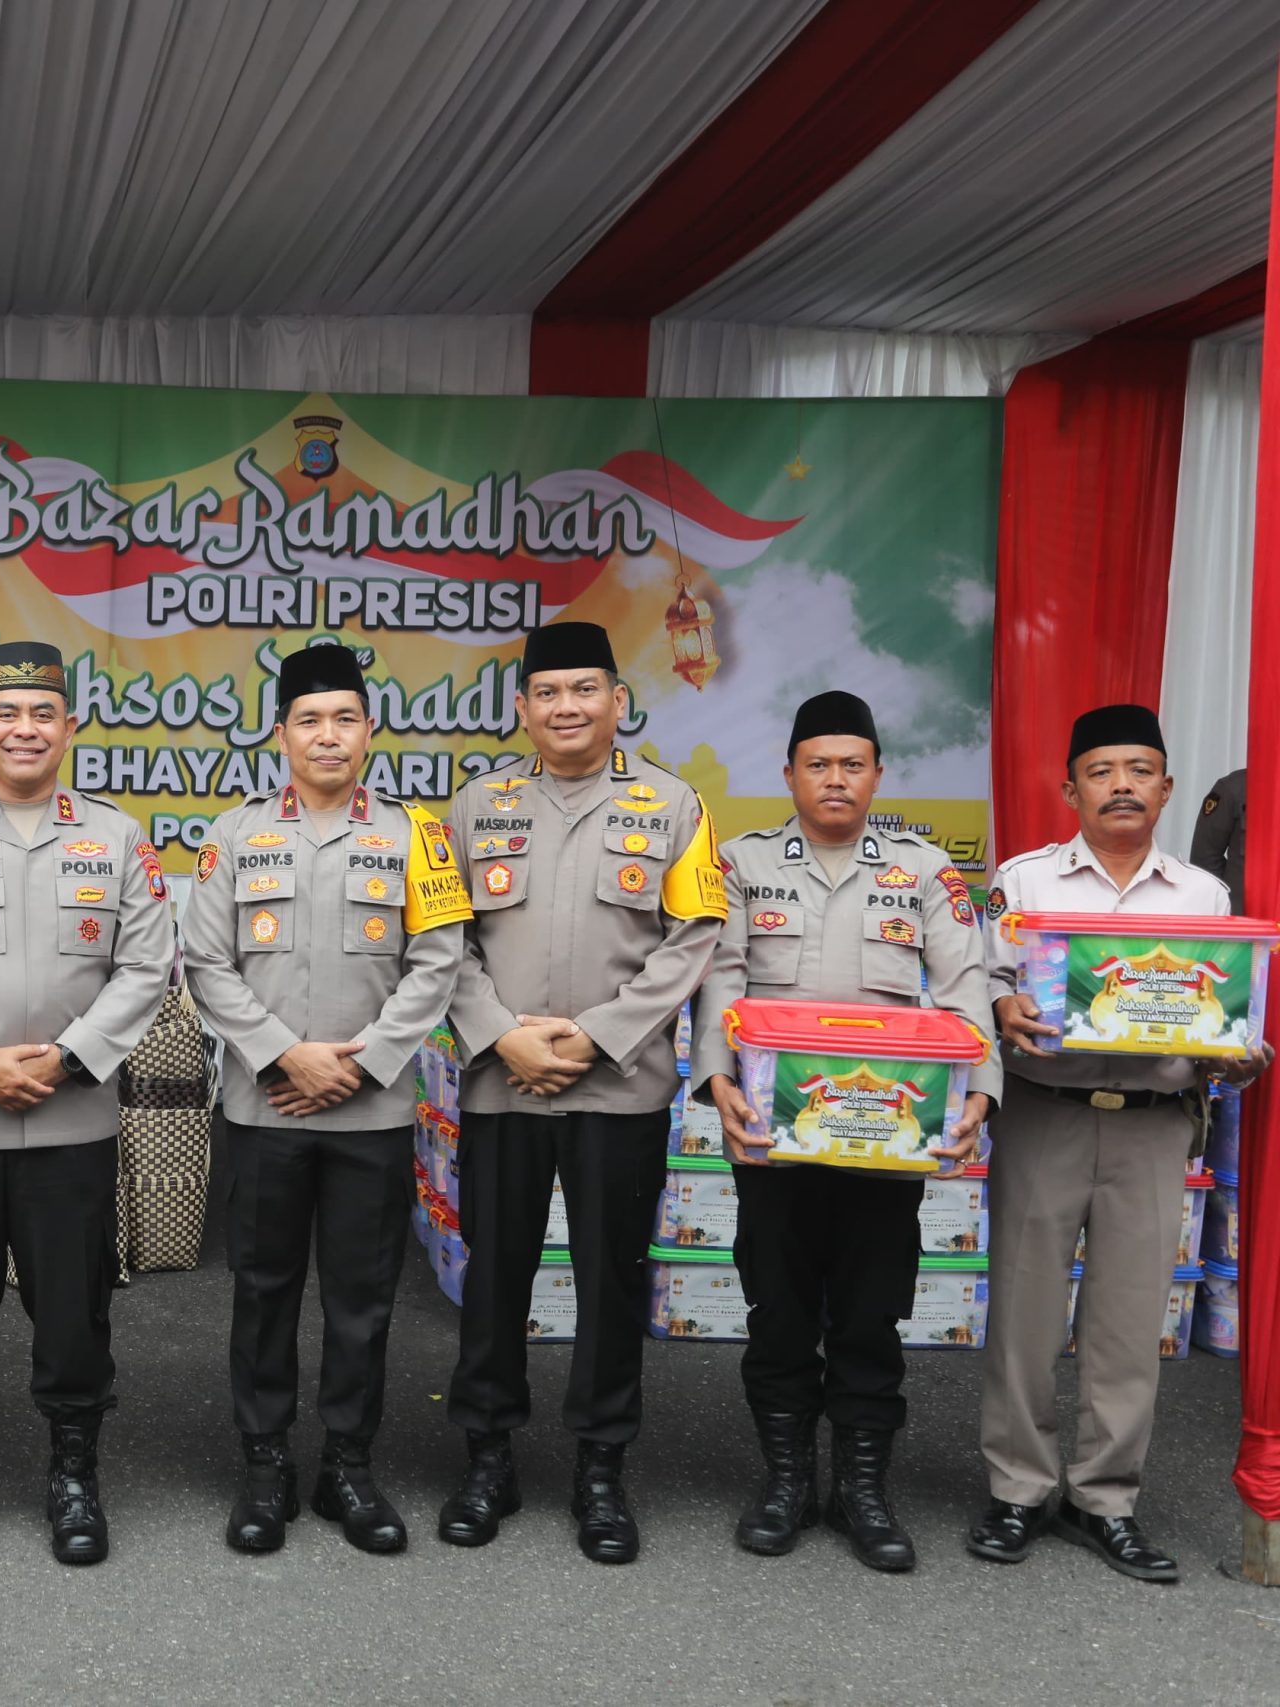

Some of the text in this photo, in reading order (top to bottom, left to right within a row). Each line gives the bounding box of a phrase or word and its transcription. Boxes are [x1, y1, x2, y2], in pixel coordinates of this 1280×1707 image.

[201, 446, 655, 573] Ramadhan
[146, 572, 540, 632] POLRI PRESISI
[73, 745, 452, 799] BHAYANARI
[474, 817, 533, 832] MASBUDHI
[607, 815, 669, 831] POLRI
[62, 861, 113, 876] POLRI
[238, 852, 294, 870] RONY.S
[349, 854, 404, 872] POLRI
[744, 887, 799, 902] INDRA
[868, 894, 922, 912] POLRI
